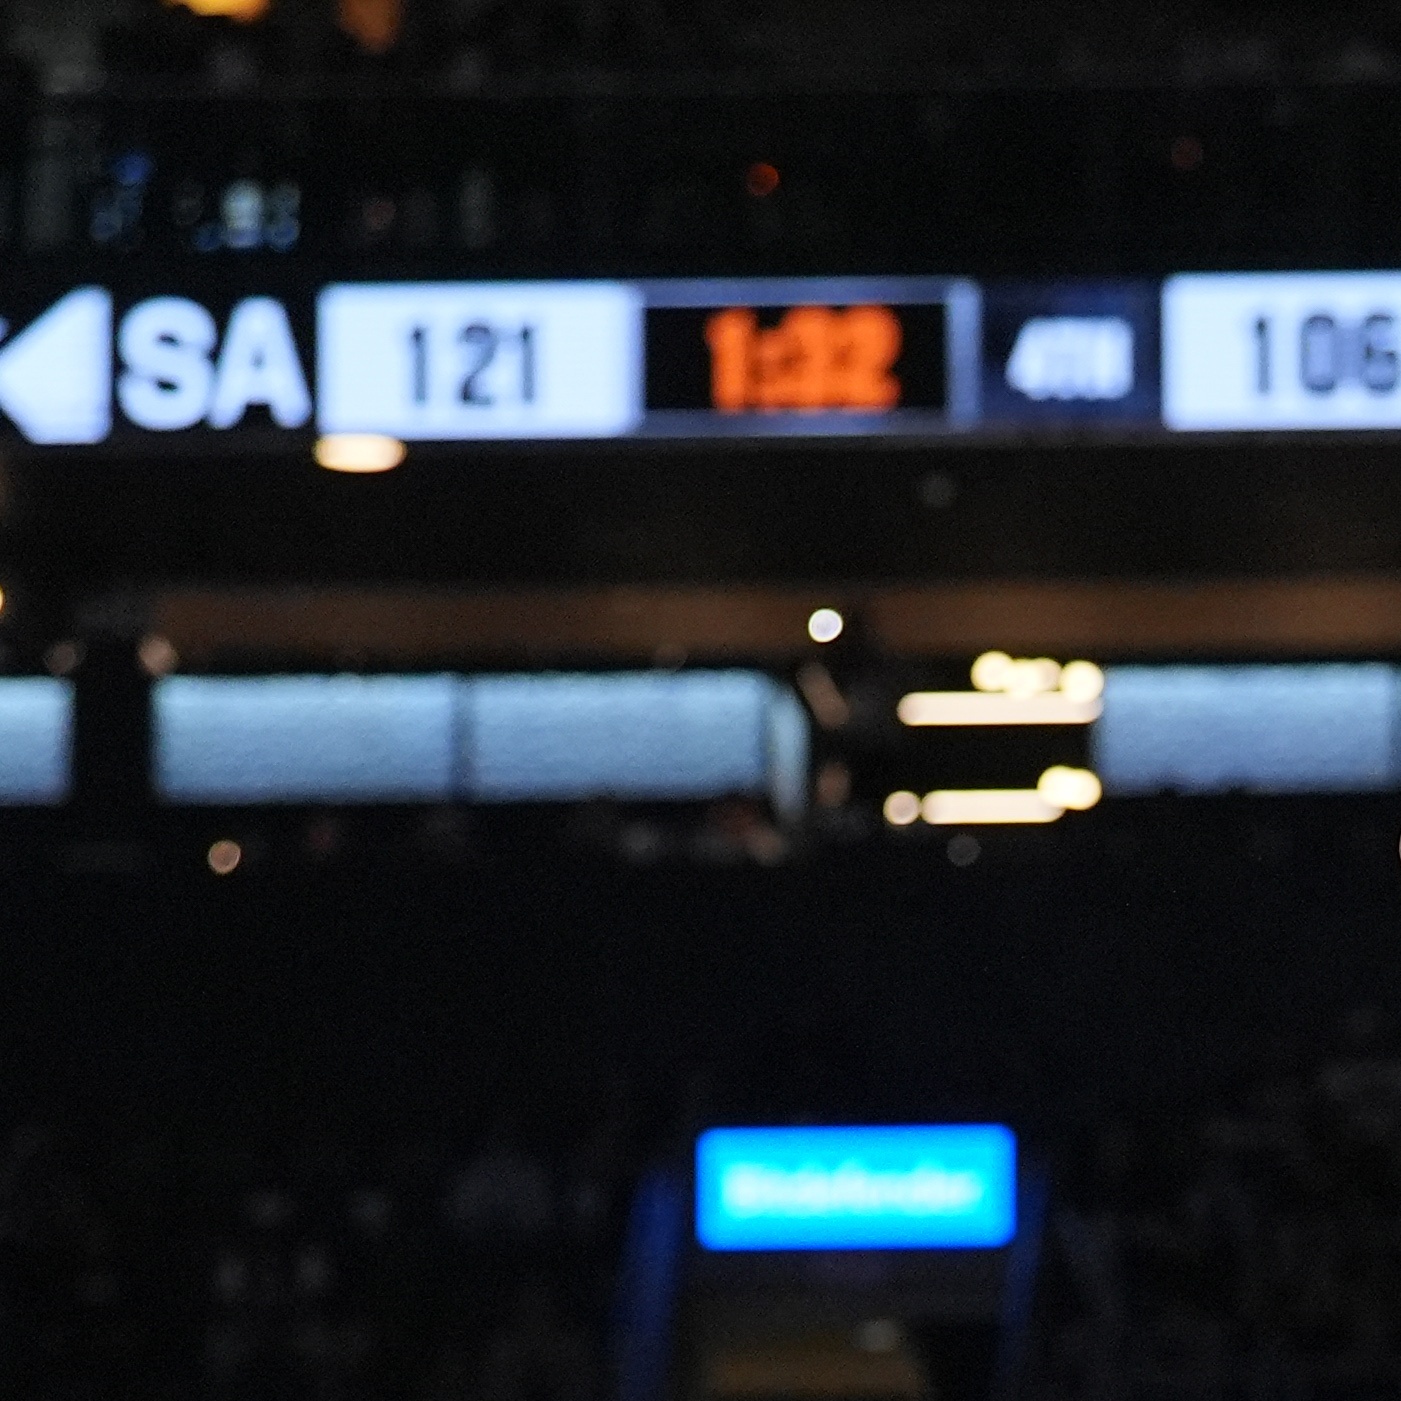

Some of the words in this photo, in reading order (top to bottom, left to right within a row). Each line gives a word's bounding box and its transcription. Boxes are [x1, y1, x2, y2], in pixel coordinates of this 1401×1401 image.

[117, 297, 309, 430] SA
[408, 322, 536, 408] 121
[1253, 311, 1401, 398] 106
